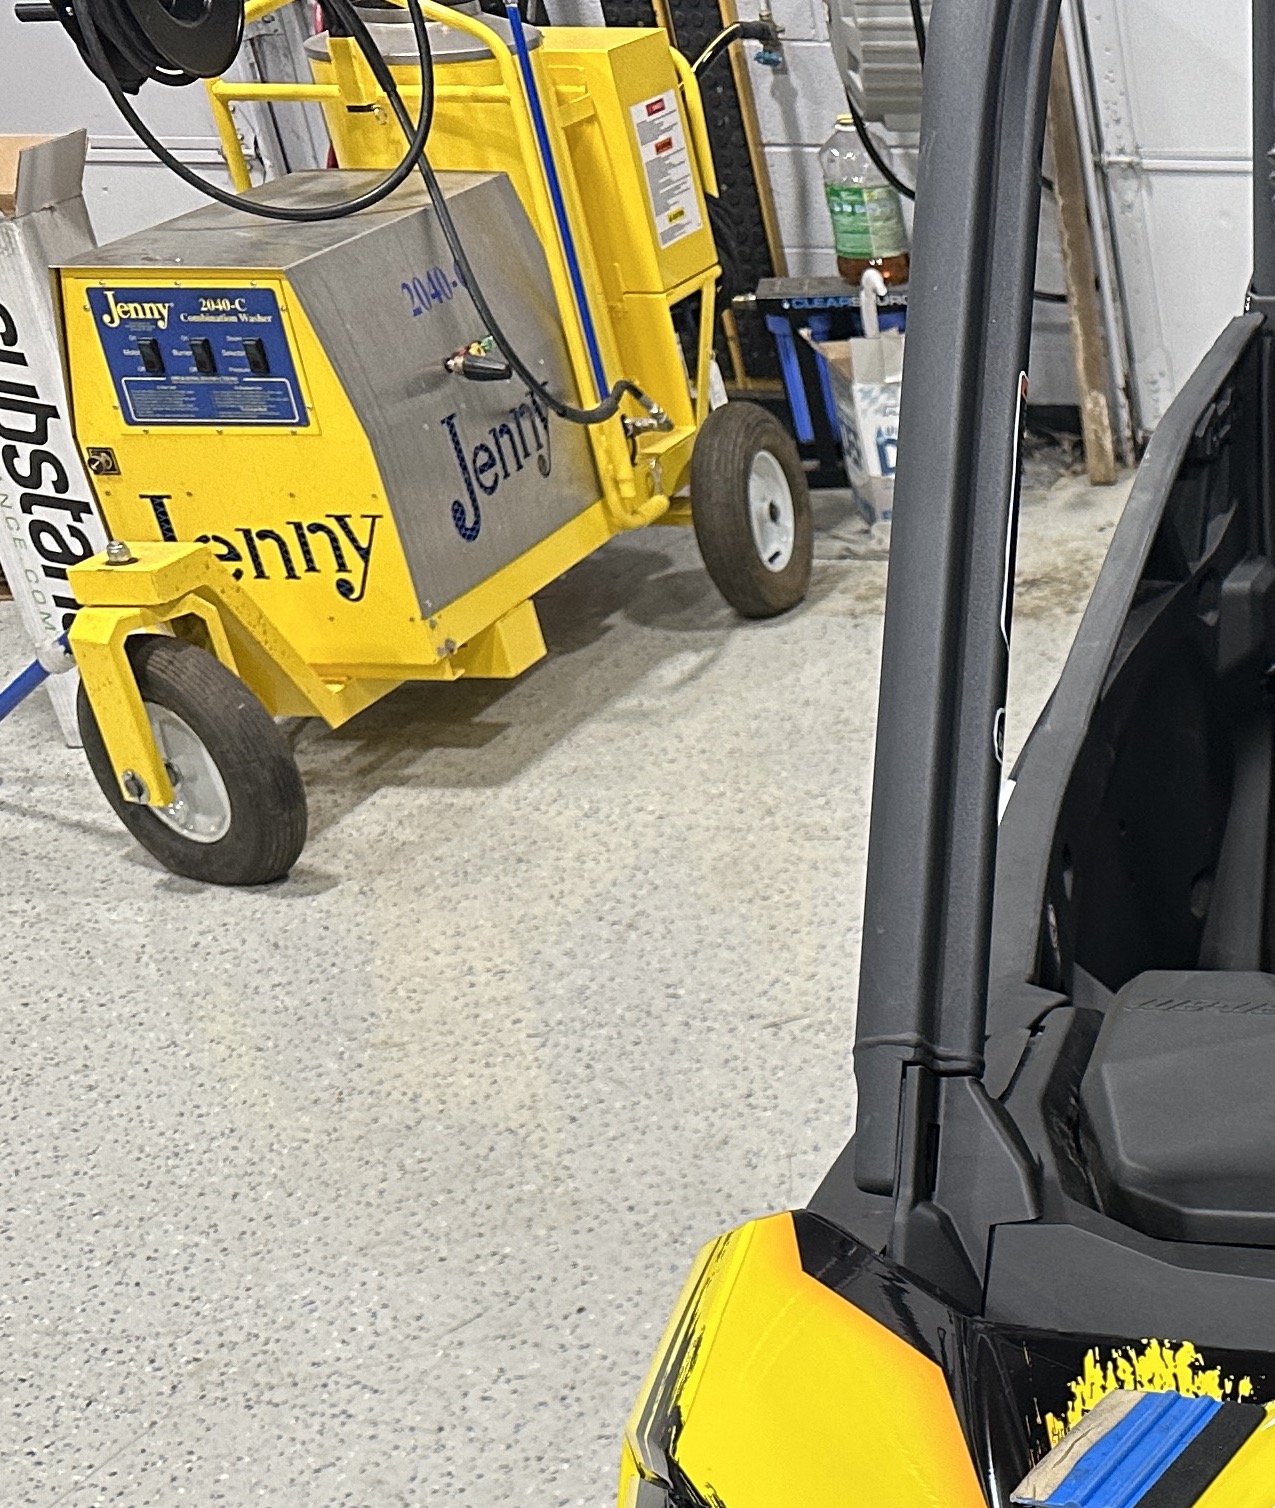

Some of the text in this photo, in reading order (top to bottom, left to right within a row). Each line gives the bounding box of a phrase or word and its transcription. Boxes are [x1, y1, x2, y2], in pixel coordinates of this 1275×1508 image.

[102, 291, 171, 329] Jenny
[198, 298, 247, 311] 2040-C
[237, 312, 273, 323] Washer
[441, 381, 549, 542] Jenny
